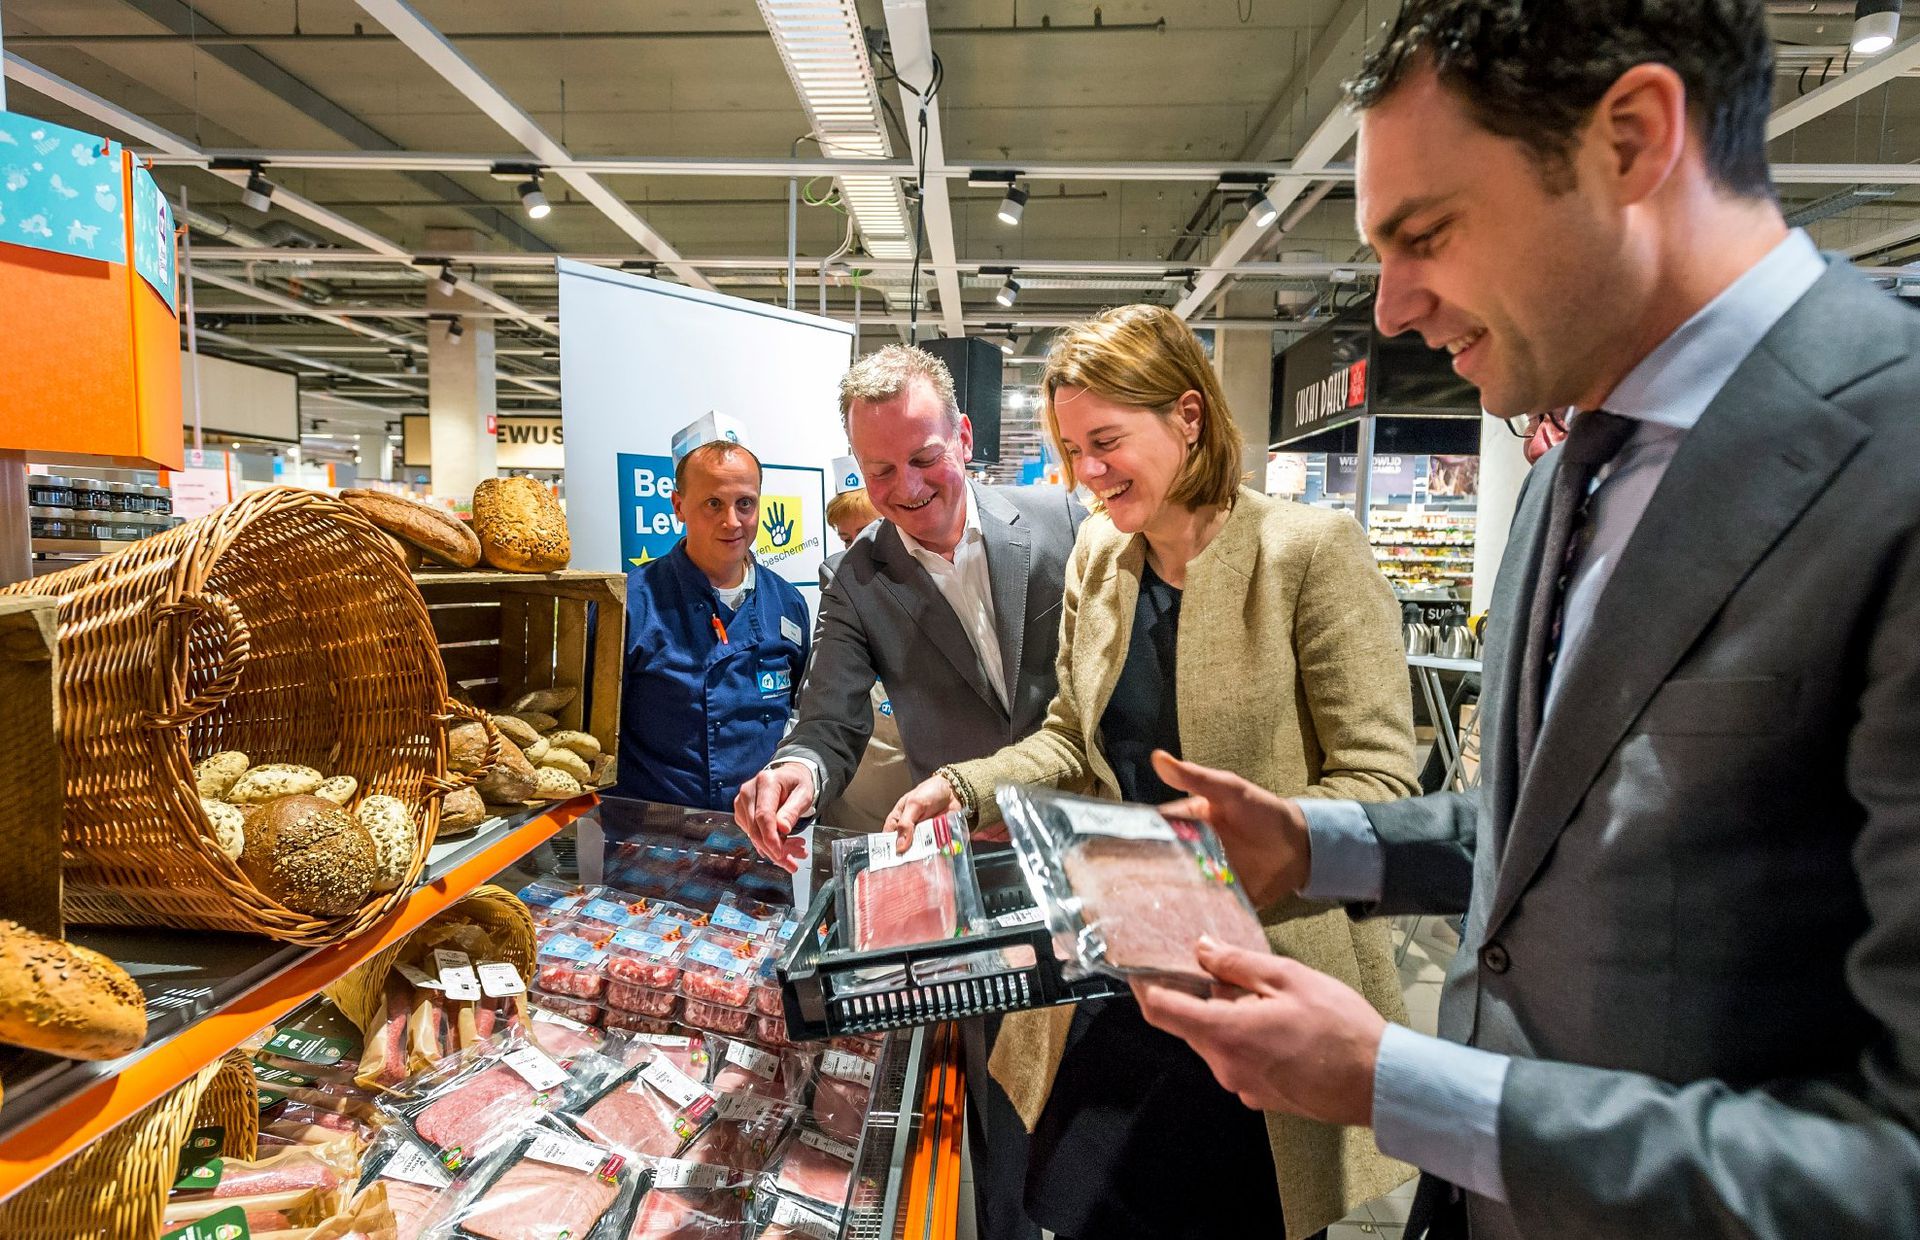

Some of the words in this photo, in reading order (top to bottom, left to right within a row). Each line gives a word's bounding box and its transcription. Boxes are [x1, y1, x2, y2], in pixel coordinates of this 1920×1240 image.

[1295, 382, 1319, 428] SUSHI
[1320, 368, 1349, 417] DAILY
[634, 468, 677, 499] Be
[762, 537, 819, 568] bescherming
